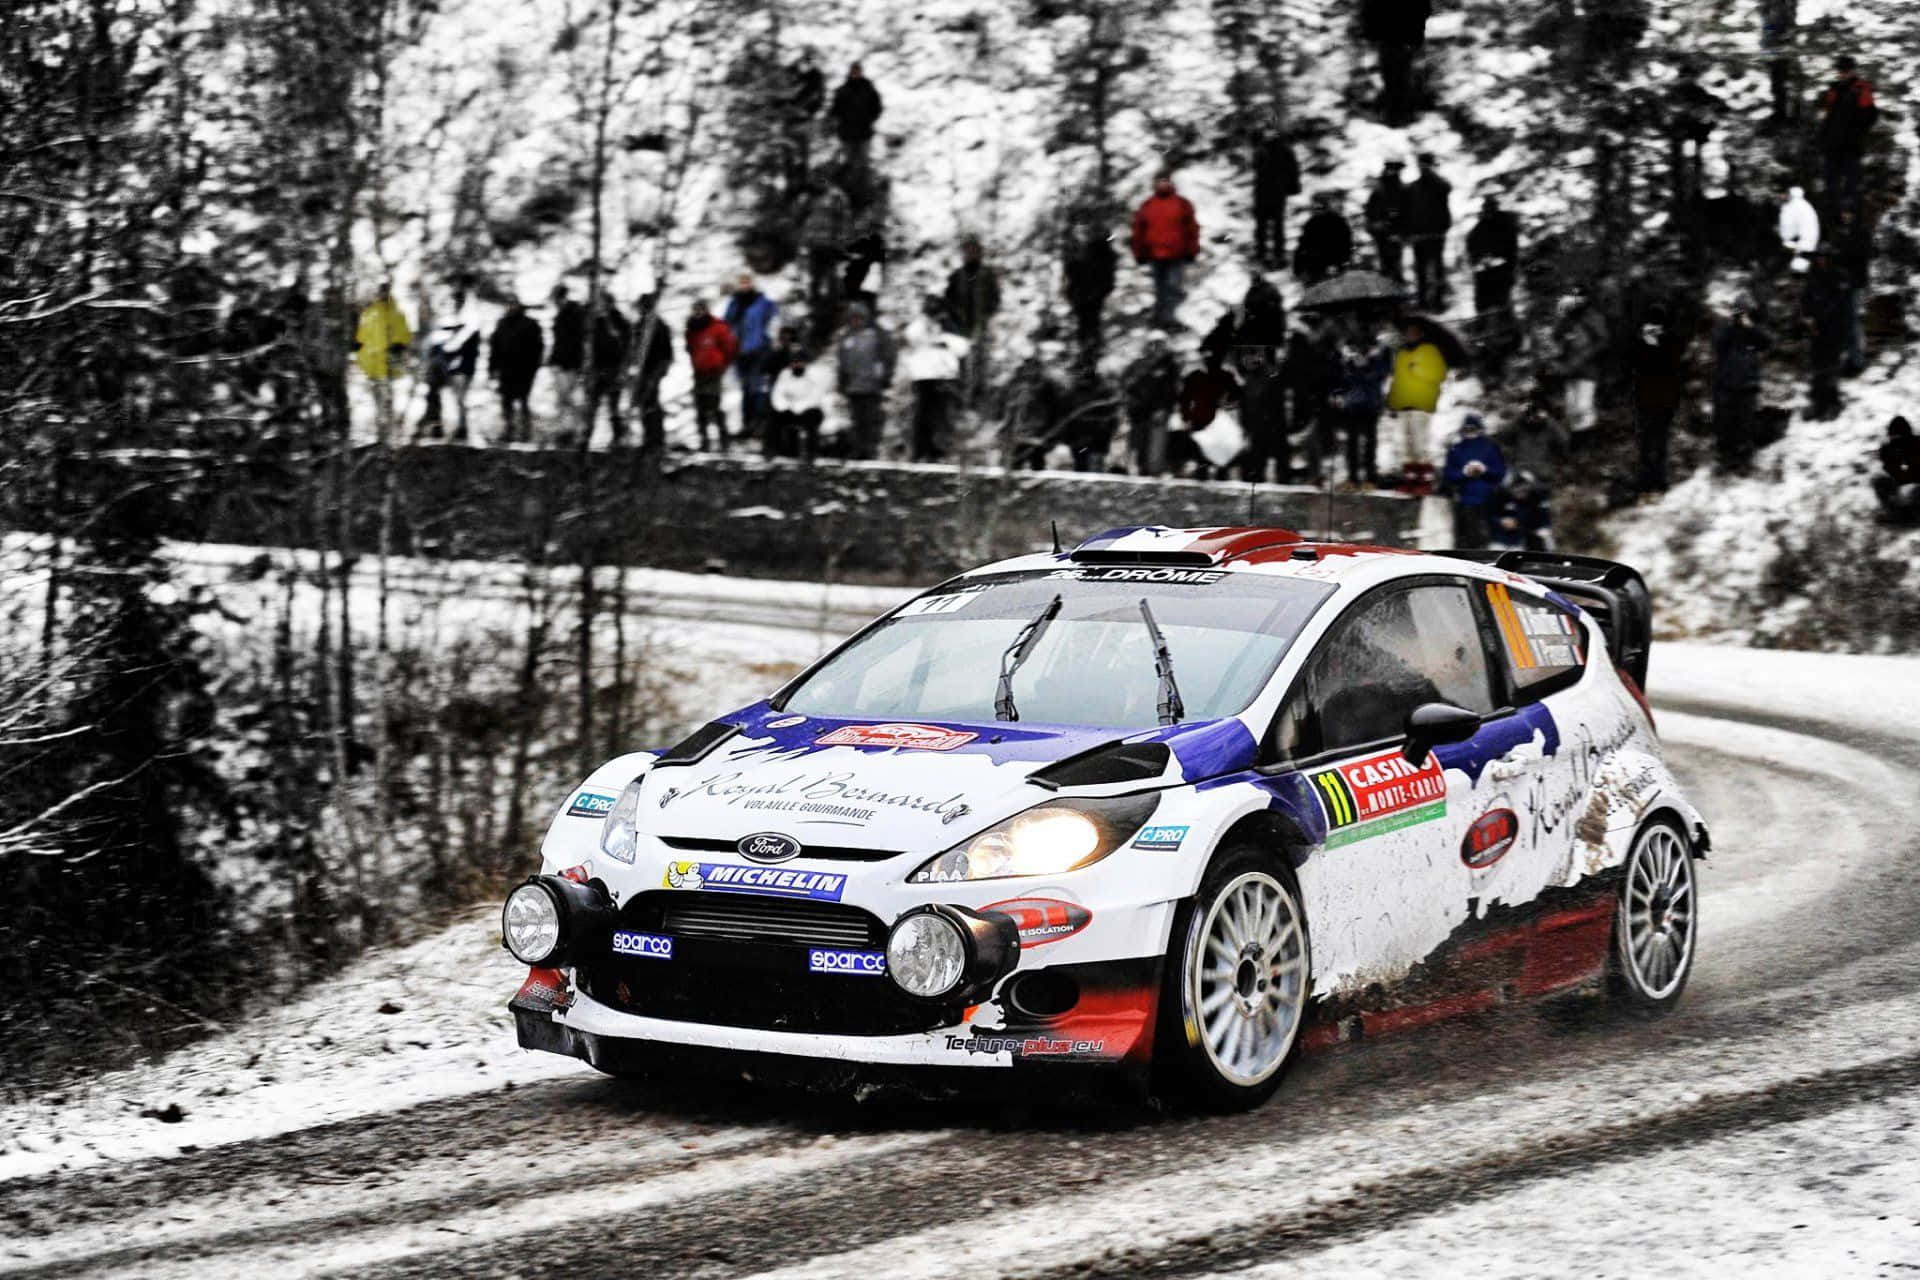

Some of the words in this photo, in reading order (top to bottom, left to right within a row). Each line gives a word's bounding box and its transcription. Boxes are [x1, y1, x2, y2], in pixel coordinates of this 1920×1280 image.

[922, 595, 959, 613] 11
[1486, 583, 1536, 670] 11
[680, 771, 806, 805] Royal
[799, 771, 964, 815] Bernard
[1318, 771, 1352, 826] 11
[1368, 774, 1445, 813] MONTE-CARLO
[743, 799, 799, 812] VOLAILLE
[800, 801, 877, 821] GOURMANDE
[749, 836, 786, 855] Ford
[1153, 828, 1185, 841] PRO
[707, 866, 844, 892] MICHELIN
[917, 869, 963, 882] PIAA
[1028, 925, 1075, 937] ISOLATION
[612, 931, 672, 955] sparco
